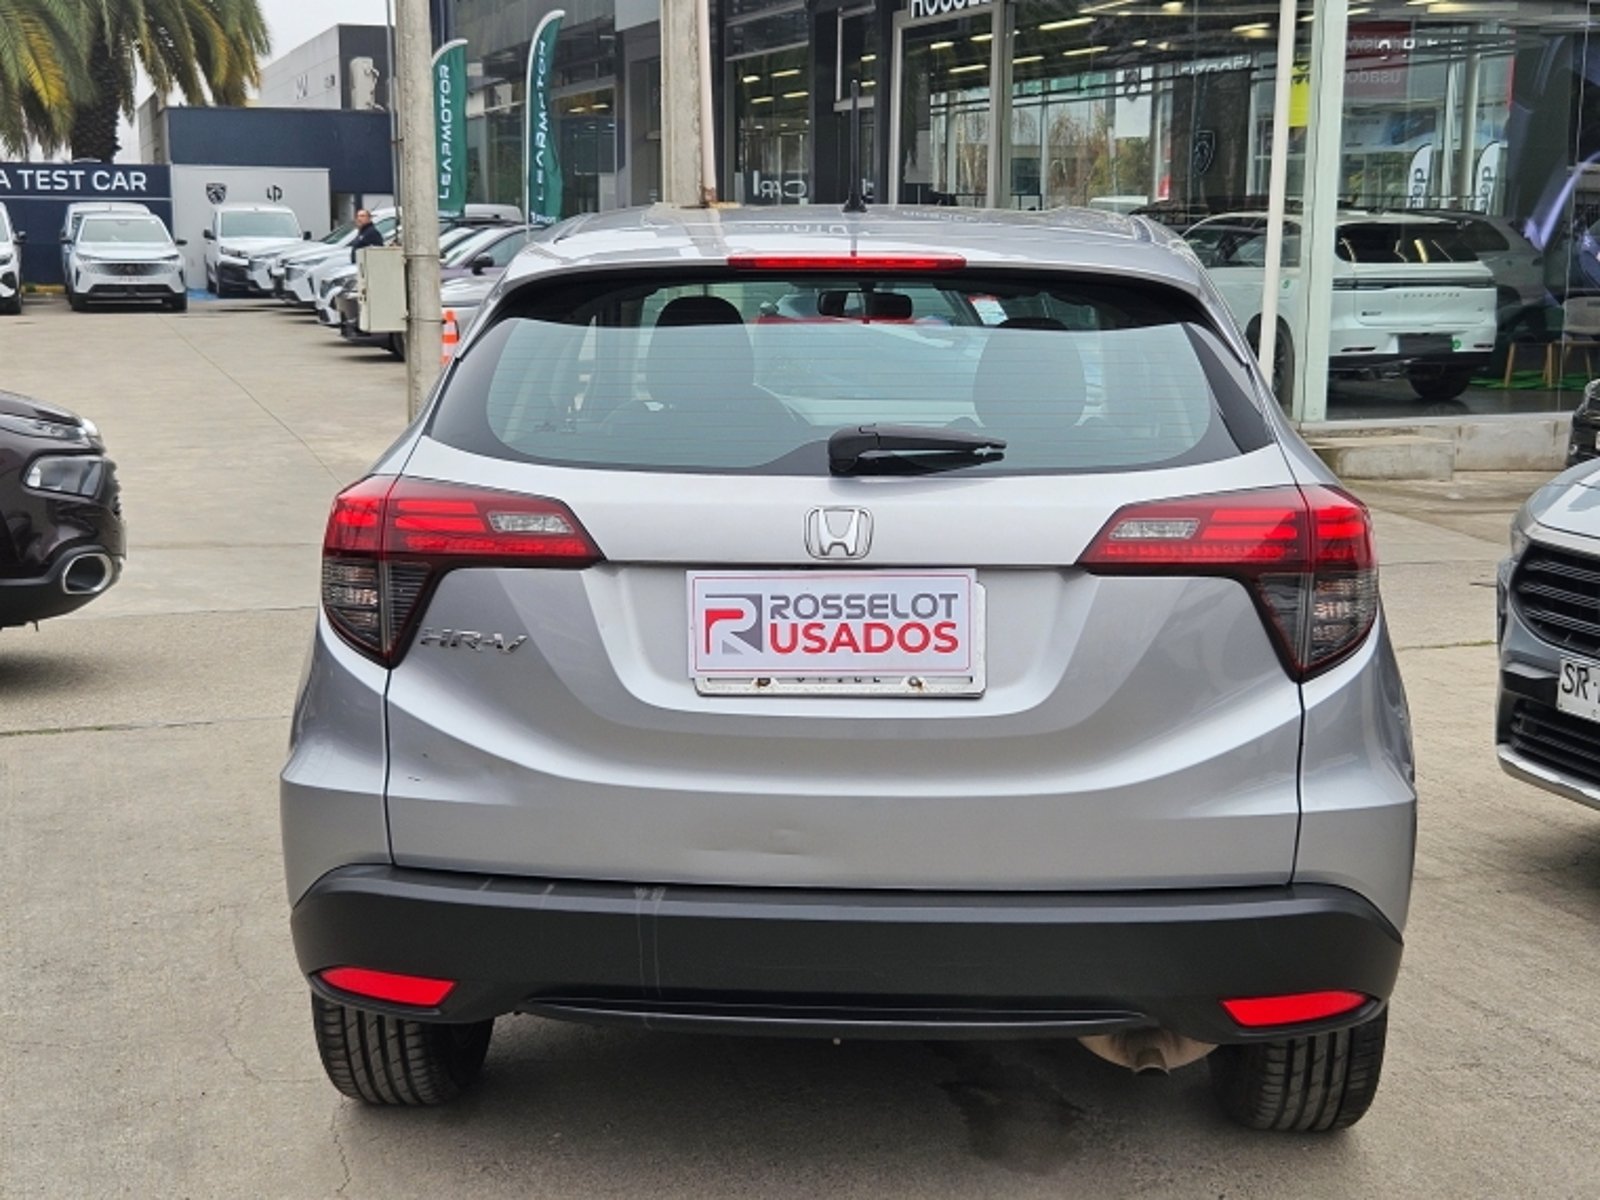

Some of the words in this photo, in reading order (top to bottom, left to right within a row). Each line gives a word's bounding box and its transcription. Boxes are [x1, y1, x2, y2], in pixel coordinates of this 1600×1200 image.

[439, 64, 453, 200] LEAPMOTOR
[16, 169, 86, 191] TEST
[92, 170, 148, 192] CAR
[769, 592, 960, 621] ROSSELOT
[769, 621, 960, 655] USADOS
